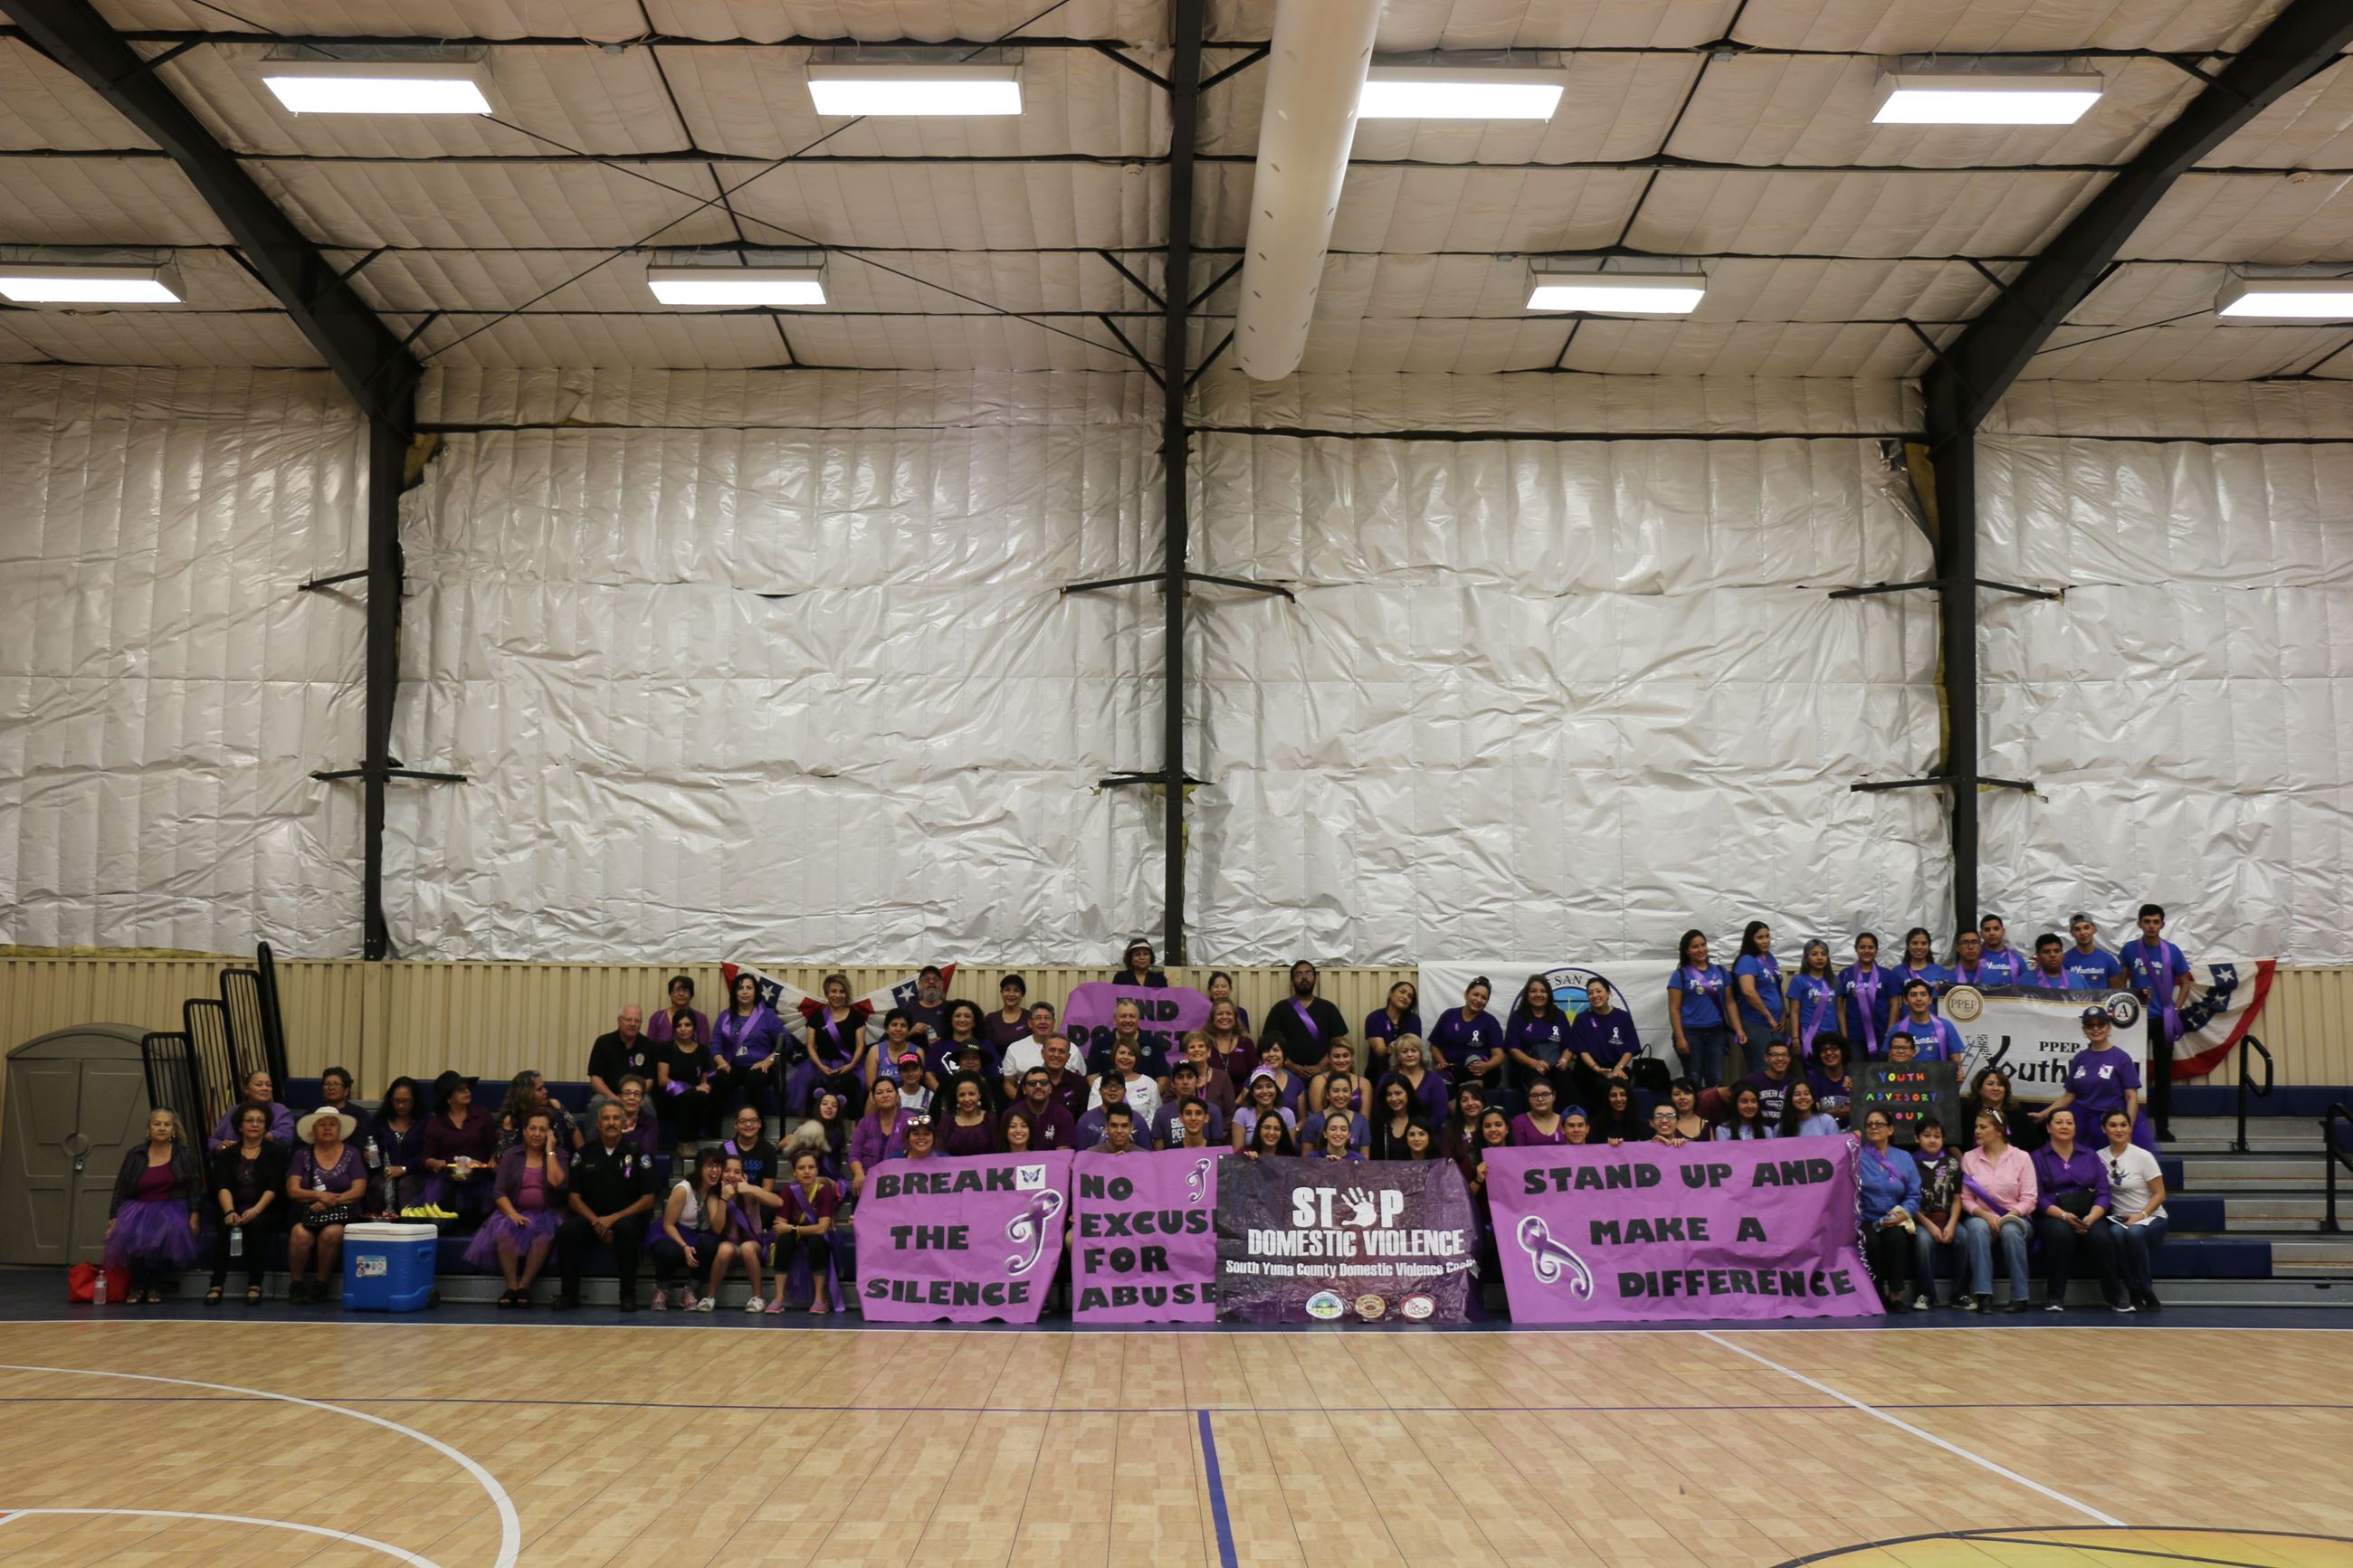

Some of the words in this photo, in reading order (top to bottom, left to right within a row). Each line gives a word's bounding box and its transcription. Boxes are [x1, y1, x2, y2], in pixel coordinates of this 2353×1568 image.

[1554, 974, 1583, 986] SAN
[1116, 997, 1179, 1022] ND
[1950, 998, 1977, 1010] PPEP
[2117, 1003, 2129, 1018] A
[2039, 1041, 2081, 1053] PPEP
[1878, 1071, 1925, 1084] YOUTH
[1866, 1092, 1937, 1101] ADVISORY
[1888, 1110, 1924, 1120] OUP
[875, 1167, 1016, 1199] BREAK
[1080, 1173, 1133, 1201] NO
[1523, 1163, 1662, 1194] STAND
[1680, 1164, 1732, 1189] UP
[1751, 1158, 1834, 1188] AND
[1080, 1209, 1217, 1238] EXCUS
[1589, 1217, 1710, 1246] MAKE
[1737, 1217, 1767, 1242] A
[891, 1225, 969, 1250] THE
[1247, 1229, 1357, 1257] DOMESTIC
[1363, 1229, 1465, 1257] VIOLENCE
[1083, 1245, 1169, 1274] FOR
[1226, 1260, 1259, 1274] South
[1262, 1262, 1294, 1277] Yuma
[1297, 1262, 1337, 1278] County
[1339, 1263, 1393, 1277] Domestic
[1396, 1262, 1443, 1276] Violence
[864, 1278, 1031, 1307] SILENCE
[1618, 1269, 1856, 1297] DIFFERENCE
